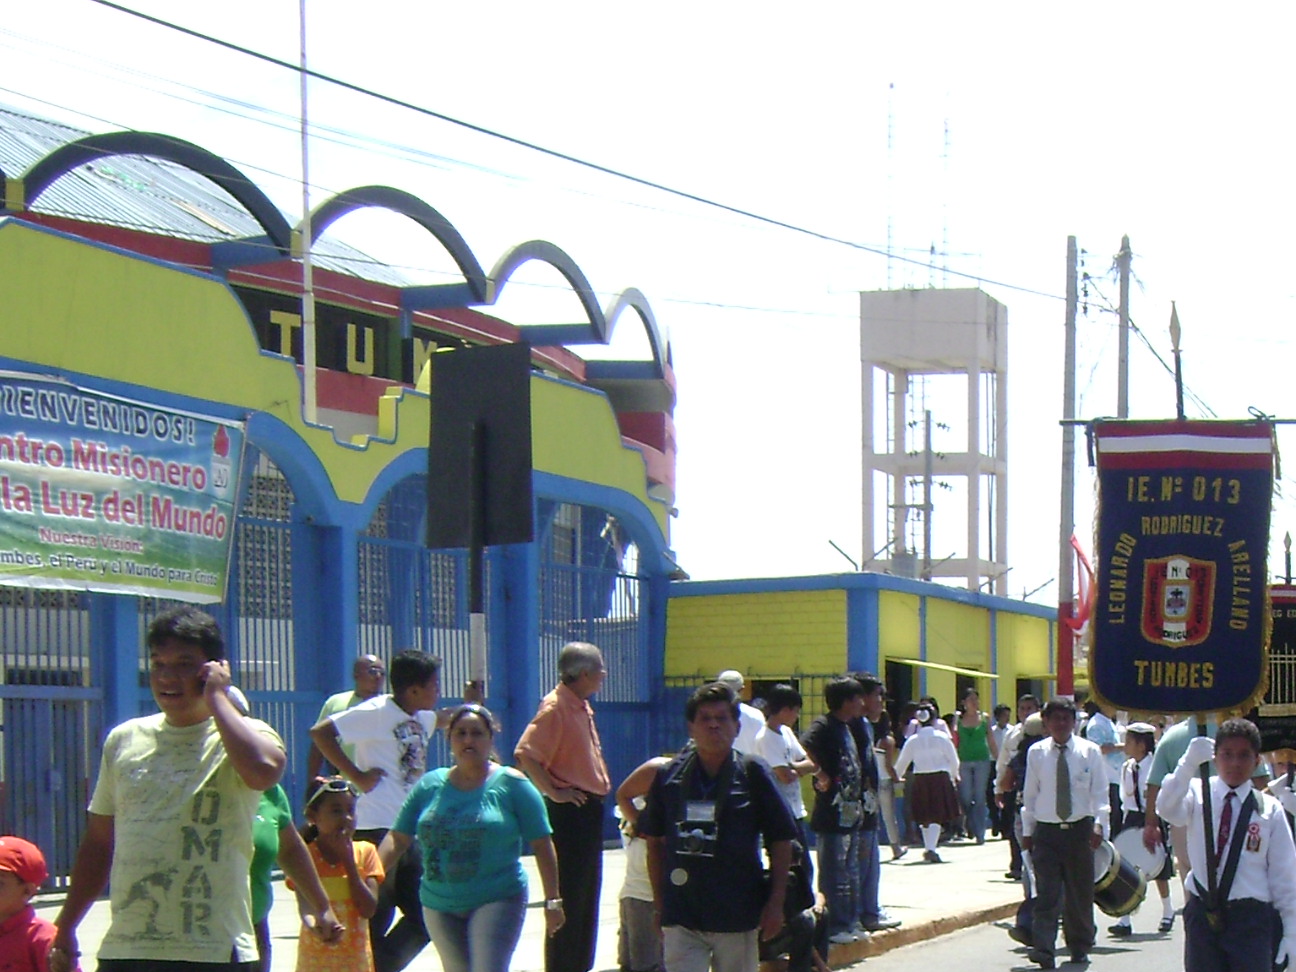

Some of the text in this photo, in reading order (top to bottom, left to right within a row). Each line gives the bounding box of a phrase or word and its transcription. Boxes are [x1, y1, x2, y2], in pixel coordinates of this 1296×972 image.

[0, 385, 196, 446] IENVENIDOS!
[72, 438, 207, 491] Misionero
[0, 476, 227, 541] la Luz del Mundo
[1192, 476, 1241, 504] 013
[39, 527, 97, 549] Nuestra
[49, 553, 63, 568] el
[100, 560, 109, 577] y
[110, 558, 123, 574] el
[125, 560, 166, 580] Mundo
[168, 567, 193, 584] para
[1108, 532, 1138, 625] LEONARDO
[1141, 515, 1225, 537] RODRIGUEZ
[1227, 539, 1252, 631] ARELLANO
[1133, 660, 1215, 689] TUMBES
